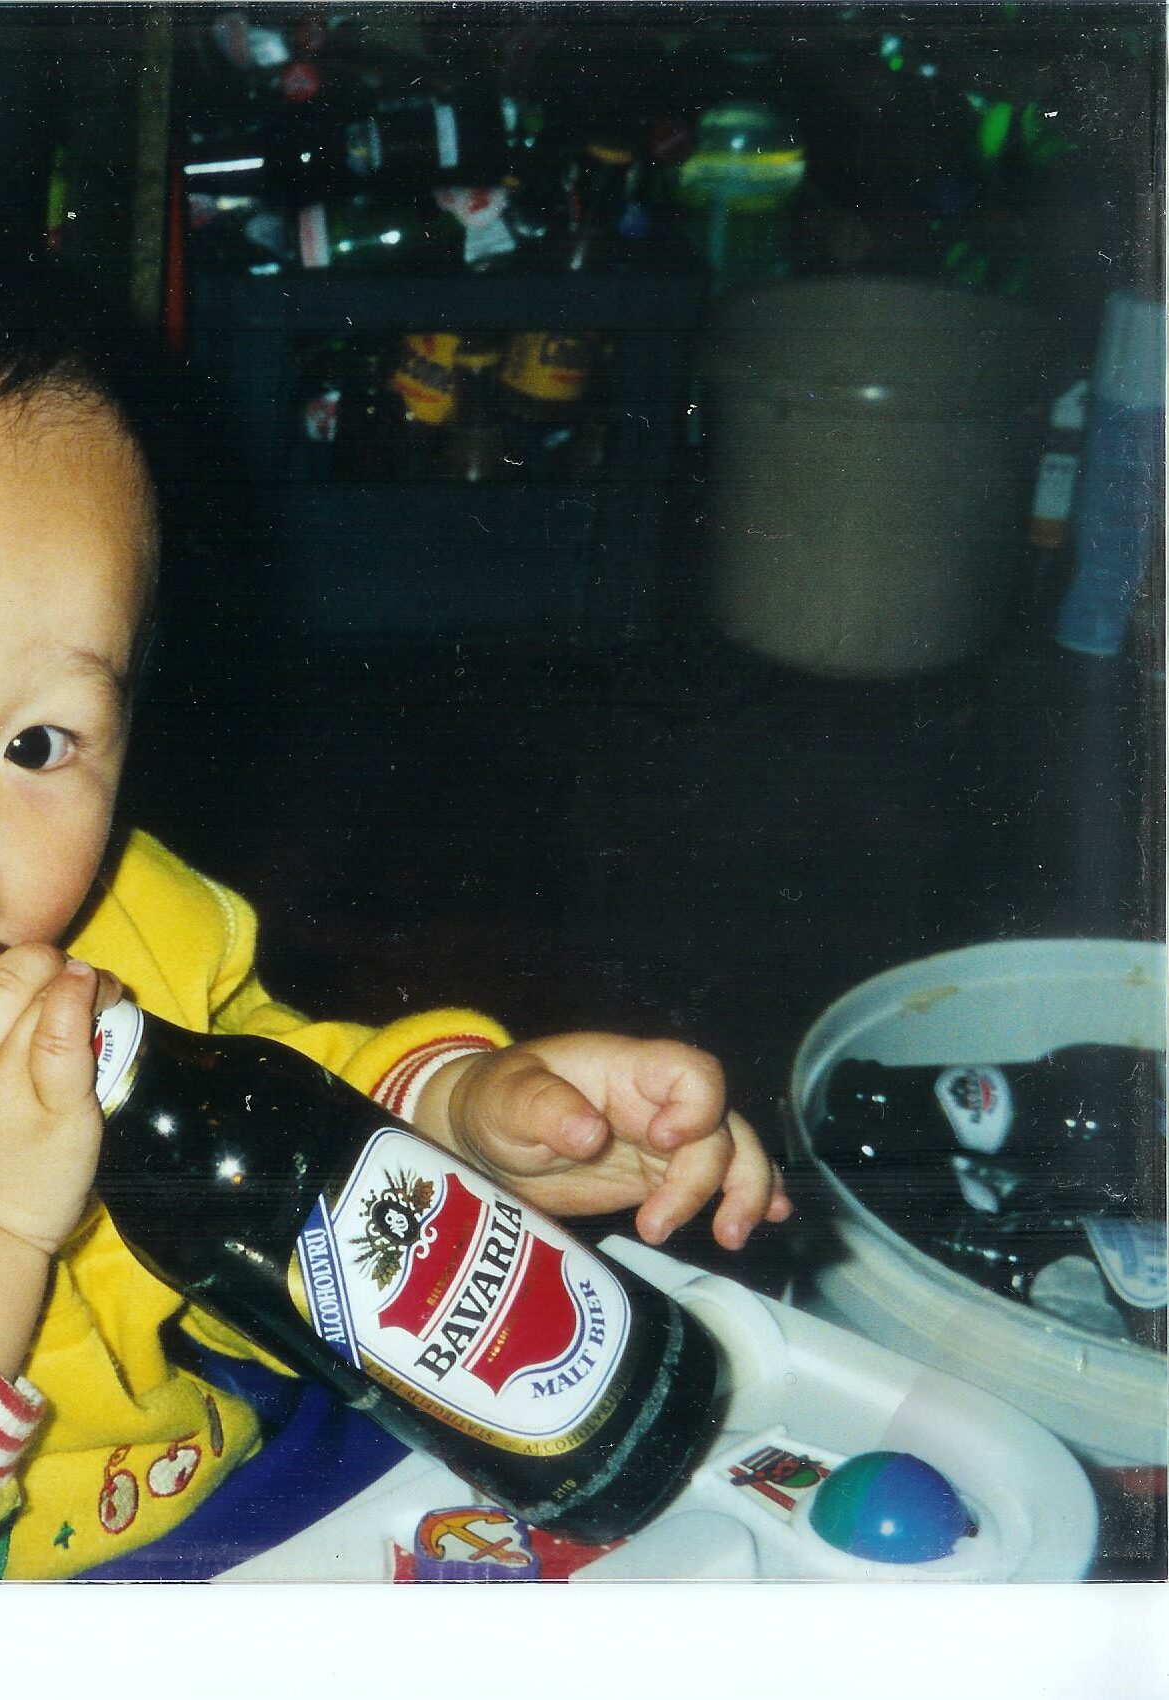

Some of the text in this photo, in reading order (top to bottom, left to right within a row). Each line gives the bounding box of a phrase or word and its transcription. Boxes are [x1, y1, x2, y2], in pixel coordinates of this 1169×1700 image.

[304, 1228, 347, 1345] ALCOHOLVRIJ
[414, 1200, 523, 1382] BAVARIA
[531, 1280, 606, 1398] MALT BIER
